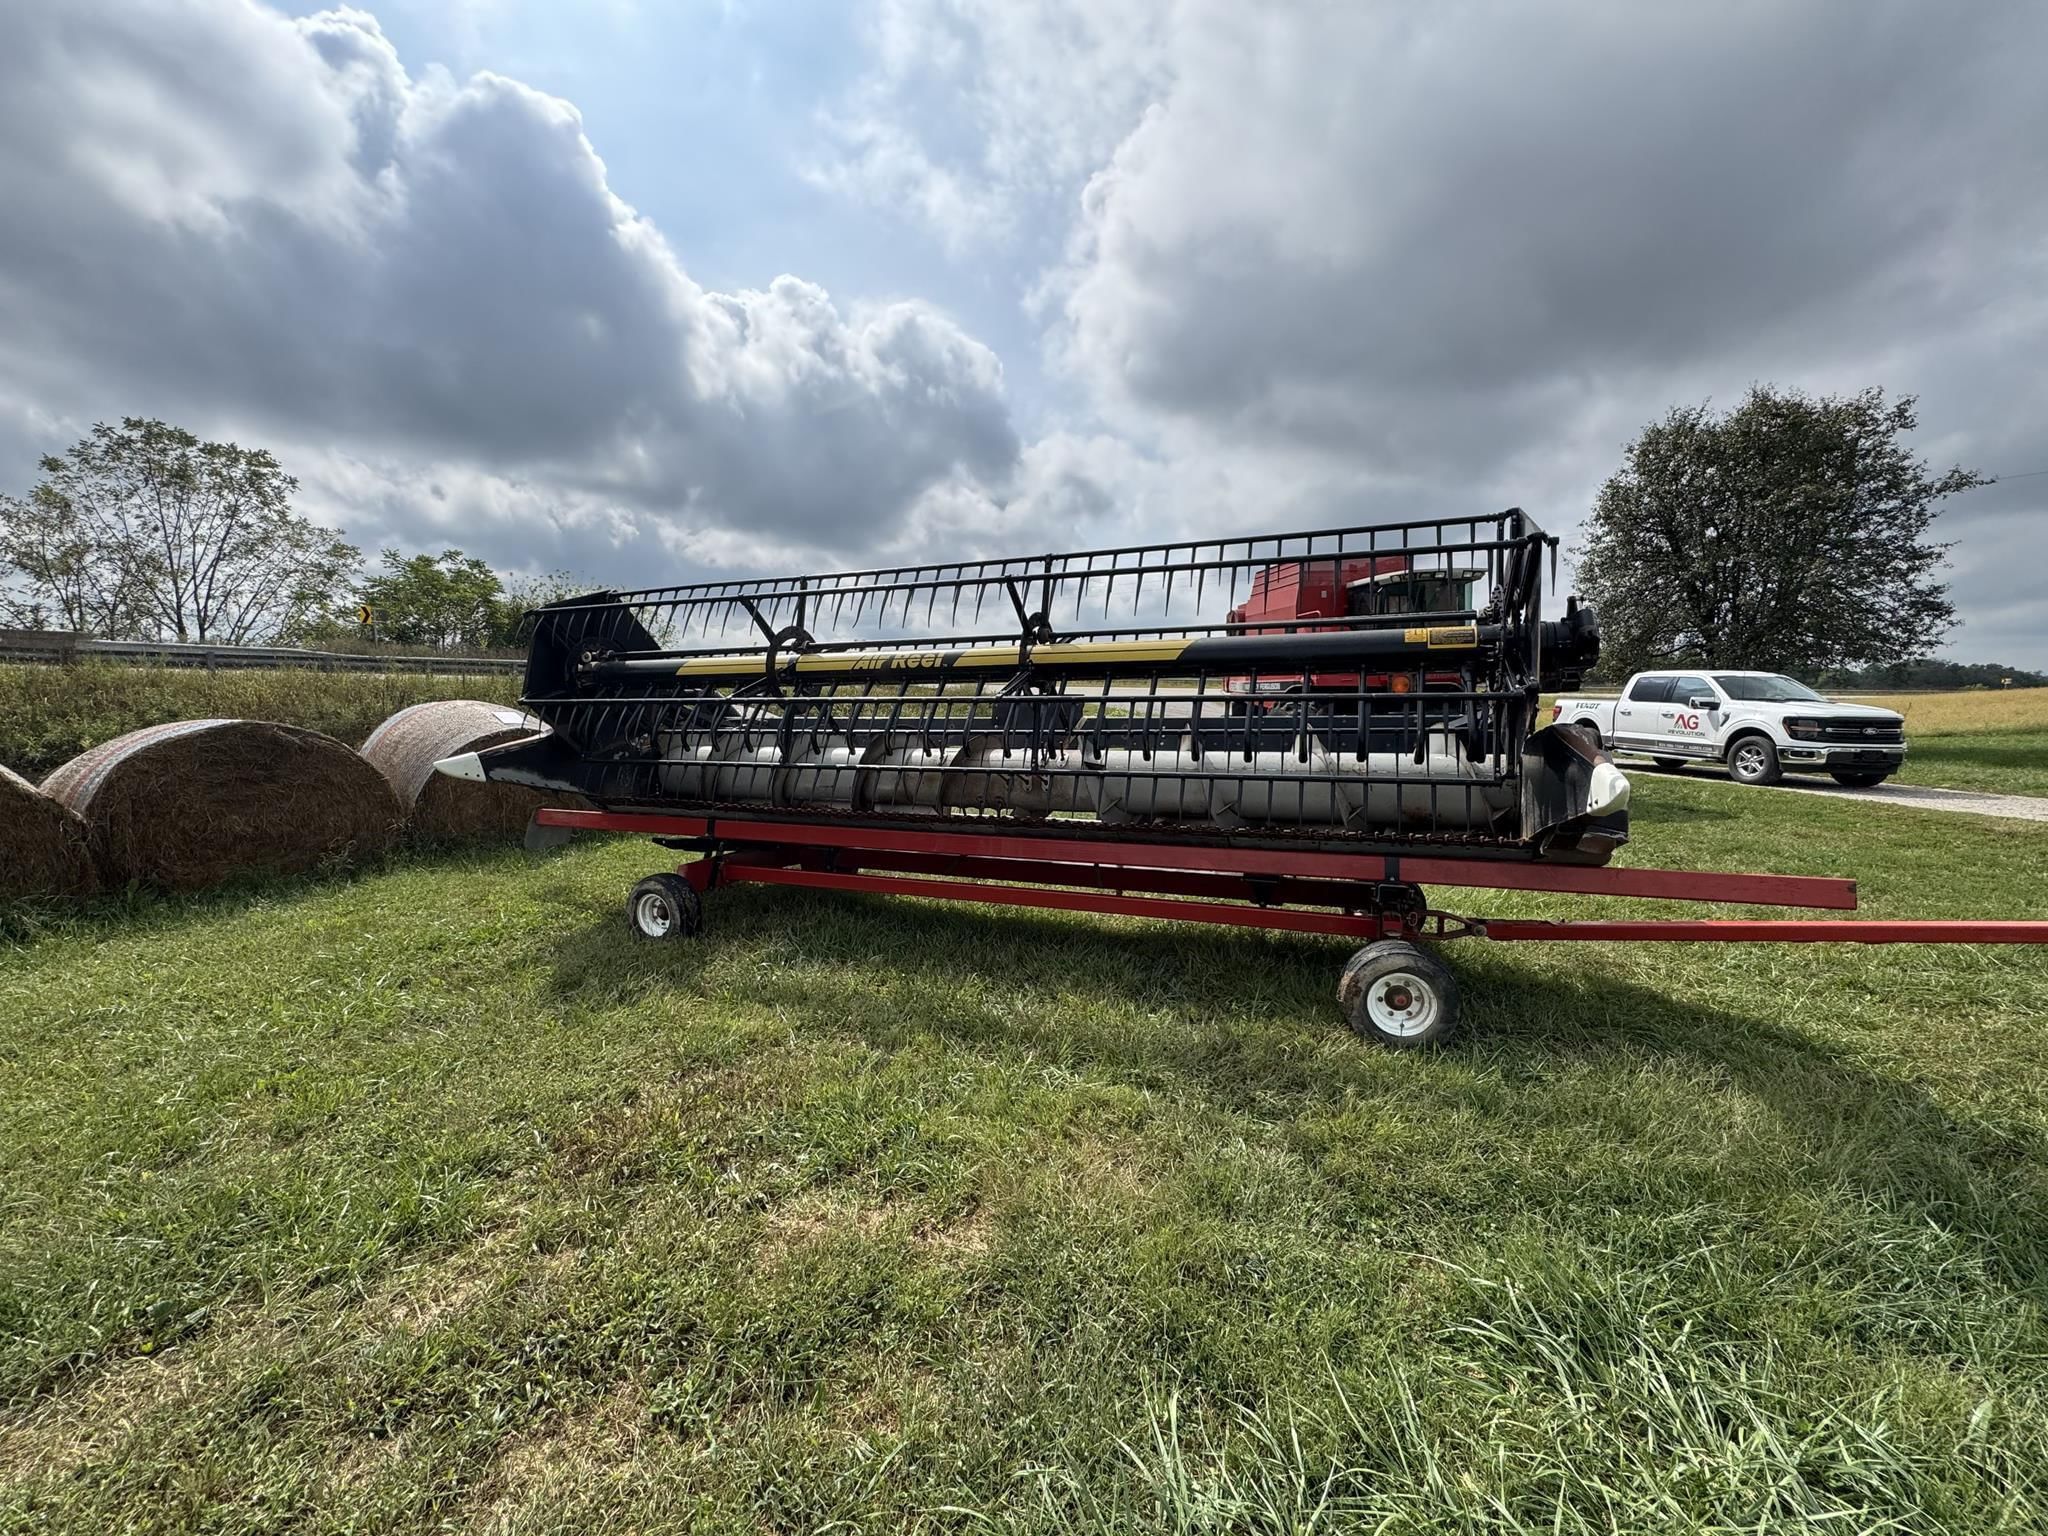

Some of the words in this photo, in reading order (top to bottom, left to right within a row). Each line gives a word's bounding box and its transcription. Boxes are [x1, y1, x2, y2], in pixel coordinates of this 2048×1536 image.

[853, 655, 890, 670] Air
[891, 652, 945, 669] Reel
[1575, 702, 1601, 710] FENDT
[1673, 713, 1700, 730] AG
[1667, 728, 1706, 737] REVOLUTION
